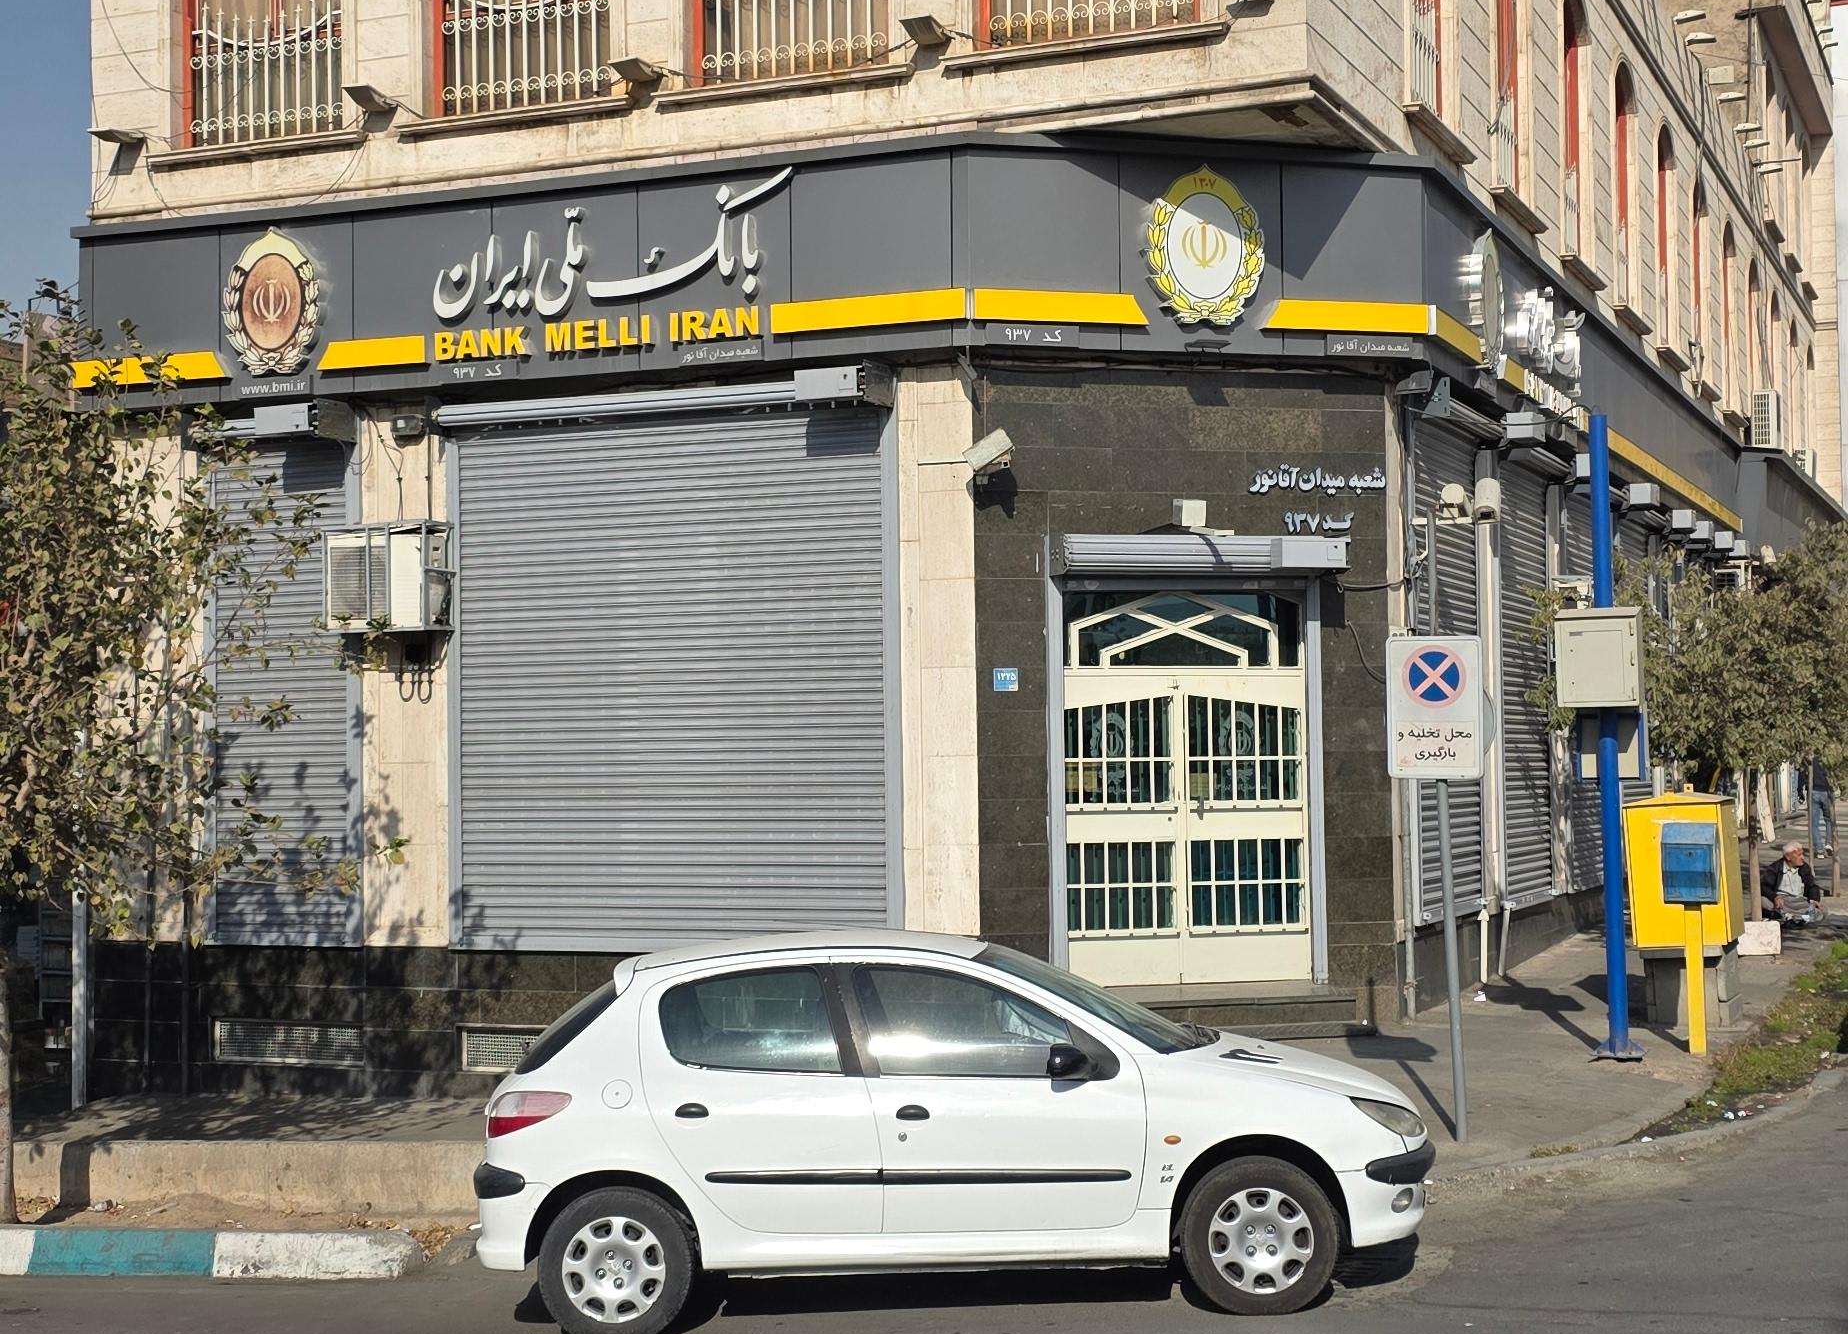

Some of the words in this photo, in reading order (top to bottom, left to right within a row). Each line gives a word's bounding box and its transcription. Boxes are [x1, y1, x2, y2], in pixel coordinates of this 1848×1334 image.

[432, 229, 538, 319] ایران
[434, 325, 527, 362] BANK
[545, 314, 651, 353] MELLI
[669, 304, 759, 343] IRAN
[1005, 328, 1032, 341] ۹۳۷
[1042, 329, 1062, 342] کد
[709, 348, 735, 361] میدان
[736, 345, 759, 359] شعبه
[1360, 341, 1386, 354] میدان
[1387, 342, 1410, 355] شعبه
[453, 366, 476, 379] ۹۳۷
[484, 364, 502, 377] کد
[241, 380, 307, 396] www.bmi.ir
[1299, 467, 1345, 495] میدان
[1348, 467, 1386, 495] شعبه
[1284, 511, 1320, 534] ۹۳۷
[1322, 511, 1355, 531] کد
[1397, 731, 1404, 742] و
[1408, 727, 1441, 741] تخلیه
[1445, 727, 1472, 742] محل
[1414, 745, 1457, 761] بارگیری
